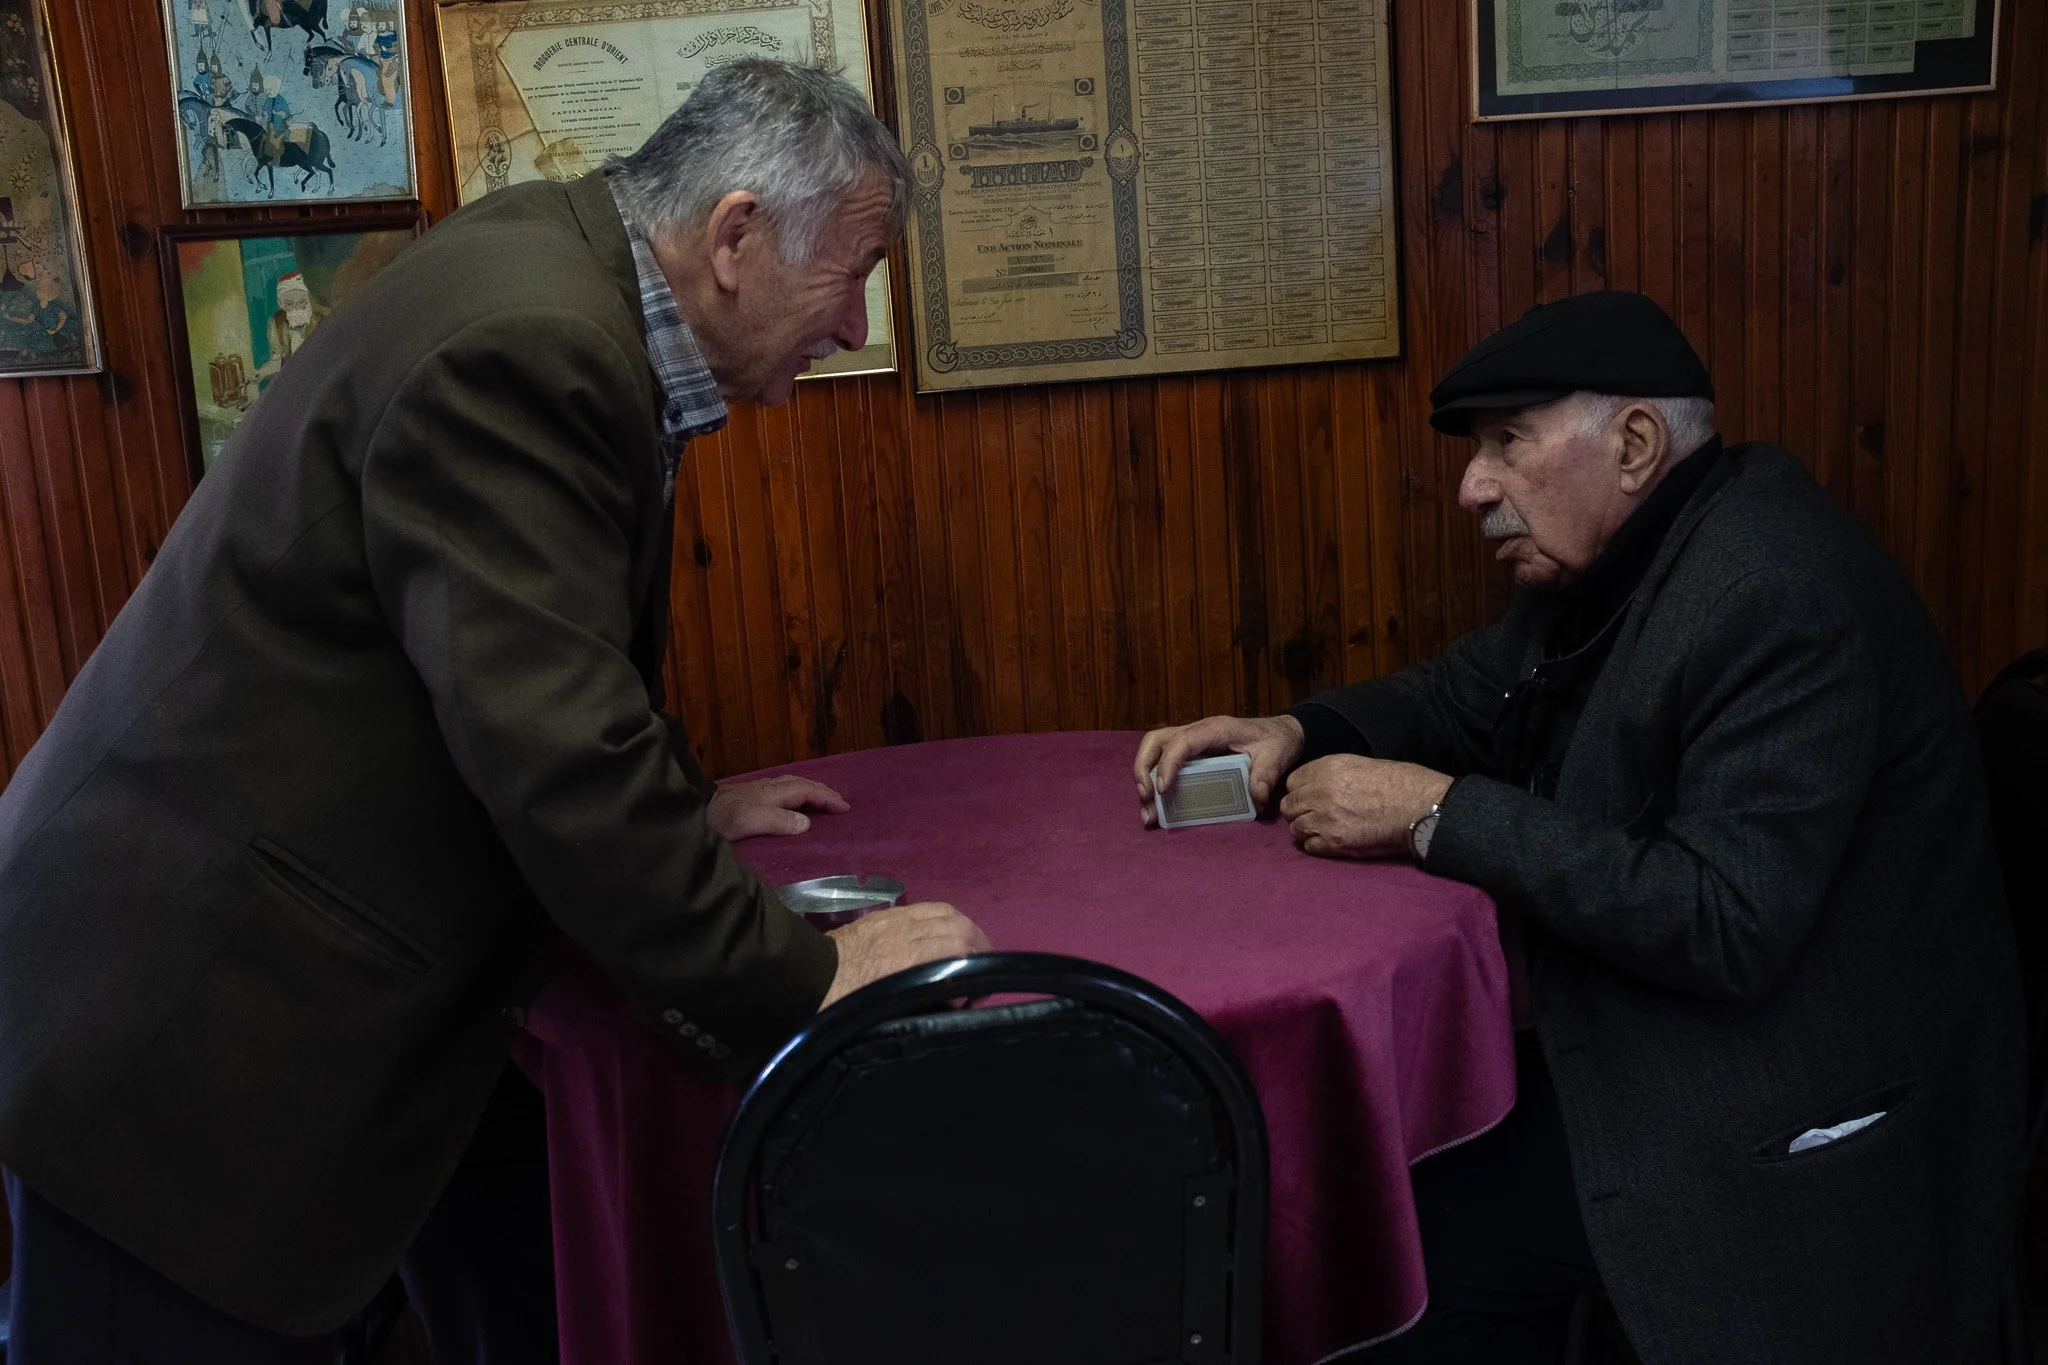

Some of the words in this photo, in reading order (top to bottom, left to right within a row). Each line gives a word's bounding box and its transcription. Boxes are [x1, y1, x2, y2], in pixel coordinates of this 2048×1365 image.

[533, 41, 563, 71] DROGUERIE
[565, 36, 599, 47] CENTRALE
[601, 41, 629, 64] D'ORIENT
[978, 244, 998, 254] UNE
[998, 242, 1032, 253] ACTION
[1034, 240, 1082, 250] NOMINALE
